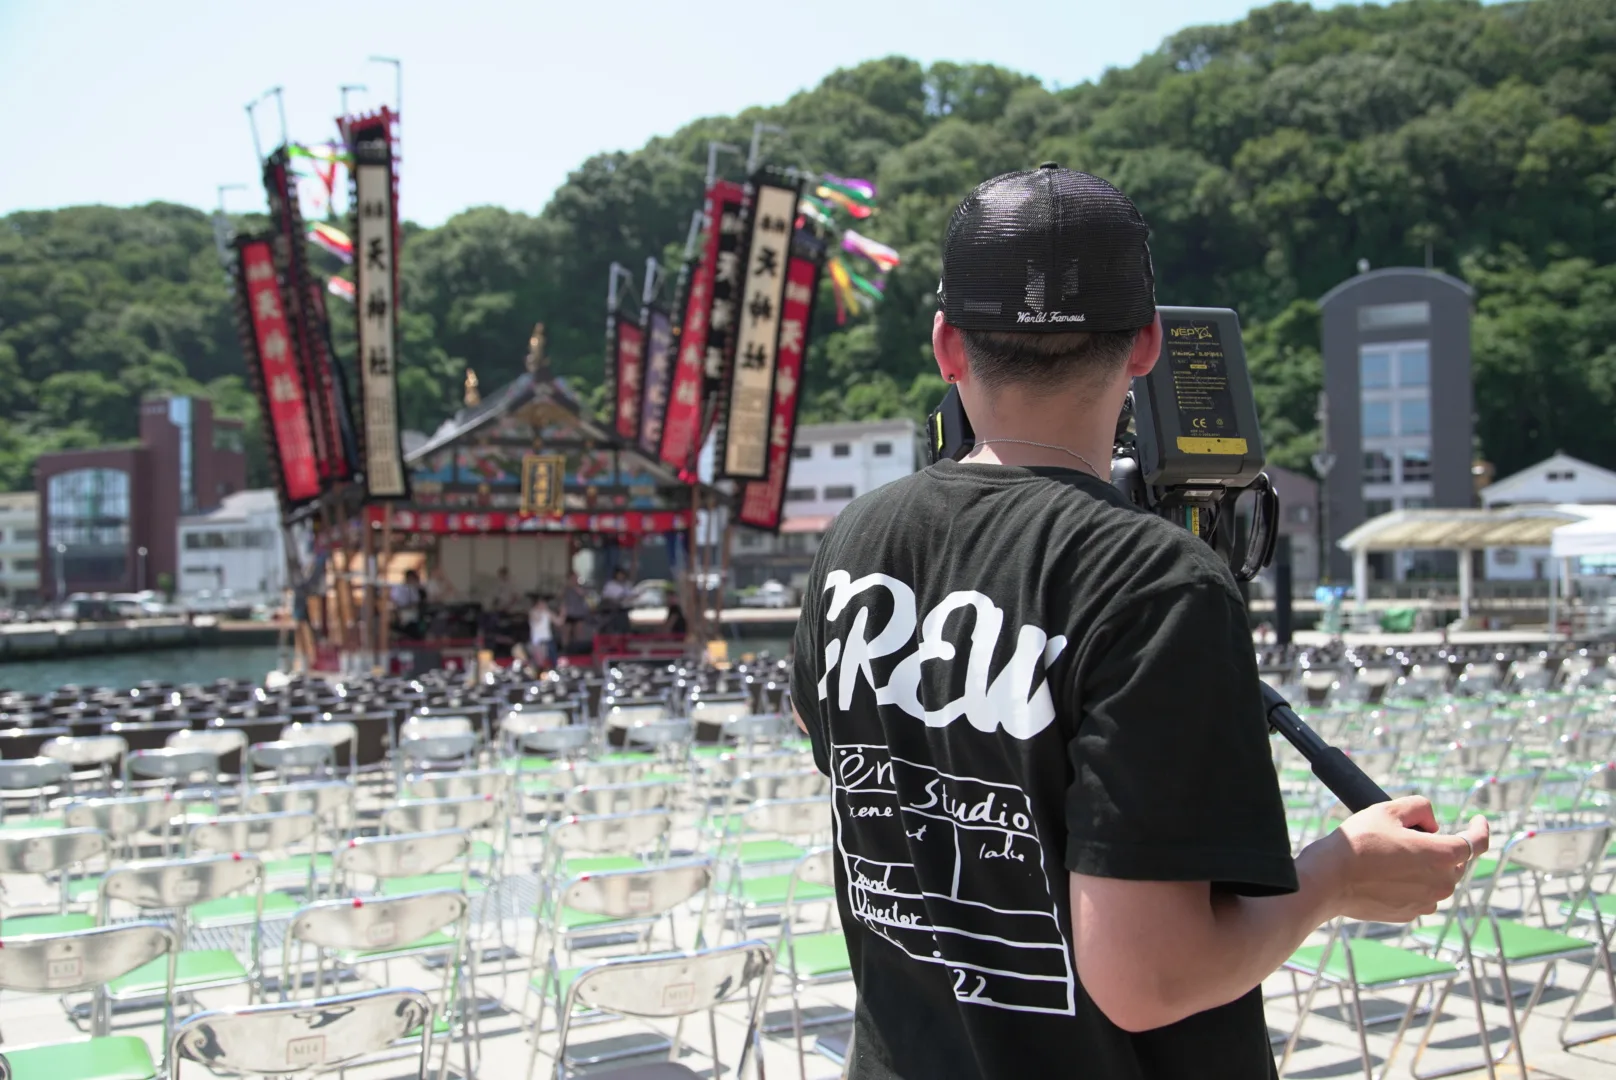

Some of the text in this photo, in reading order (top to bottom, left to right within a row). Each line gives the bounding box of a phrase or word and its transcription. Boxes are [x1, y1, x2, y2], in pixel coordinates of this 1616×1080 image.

[1016, 311, 1085, 323] World Famous
[910, 778, 1029, 830] Studio
[856, 886, 922, 926] Director
